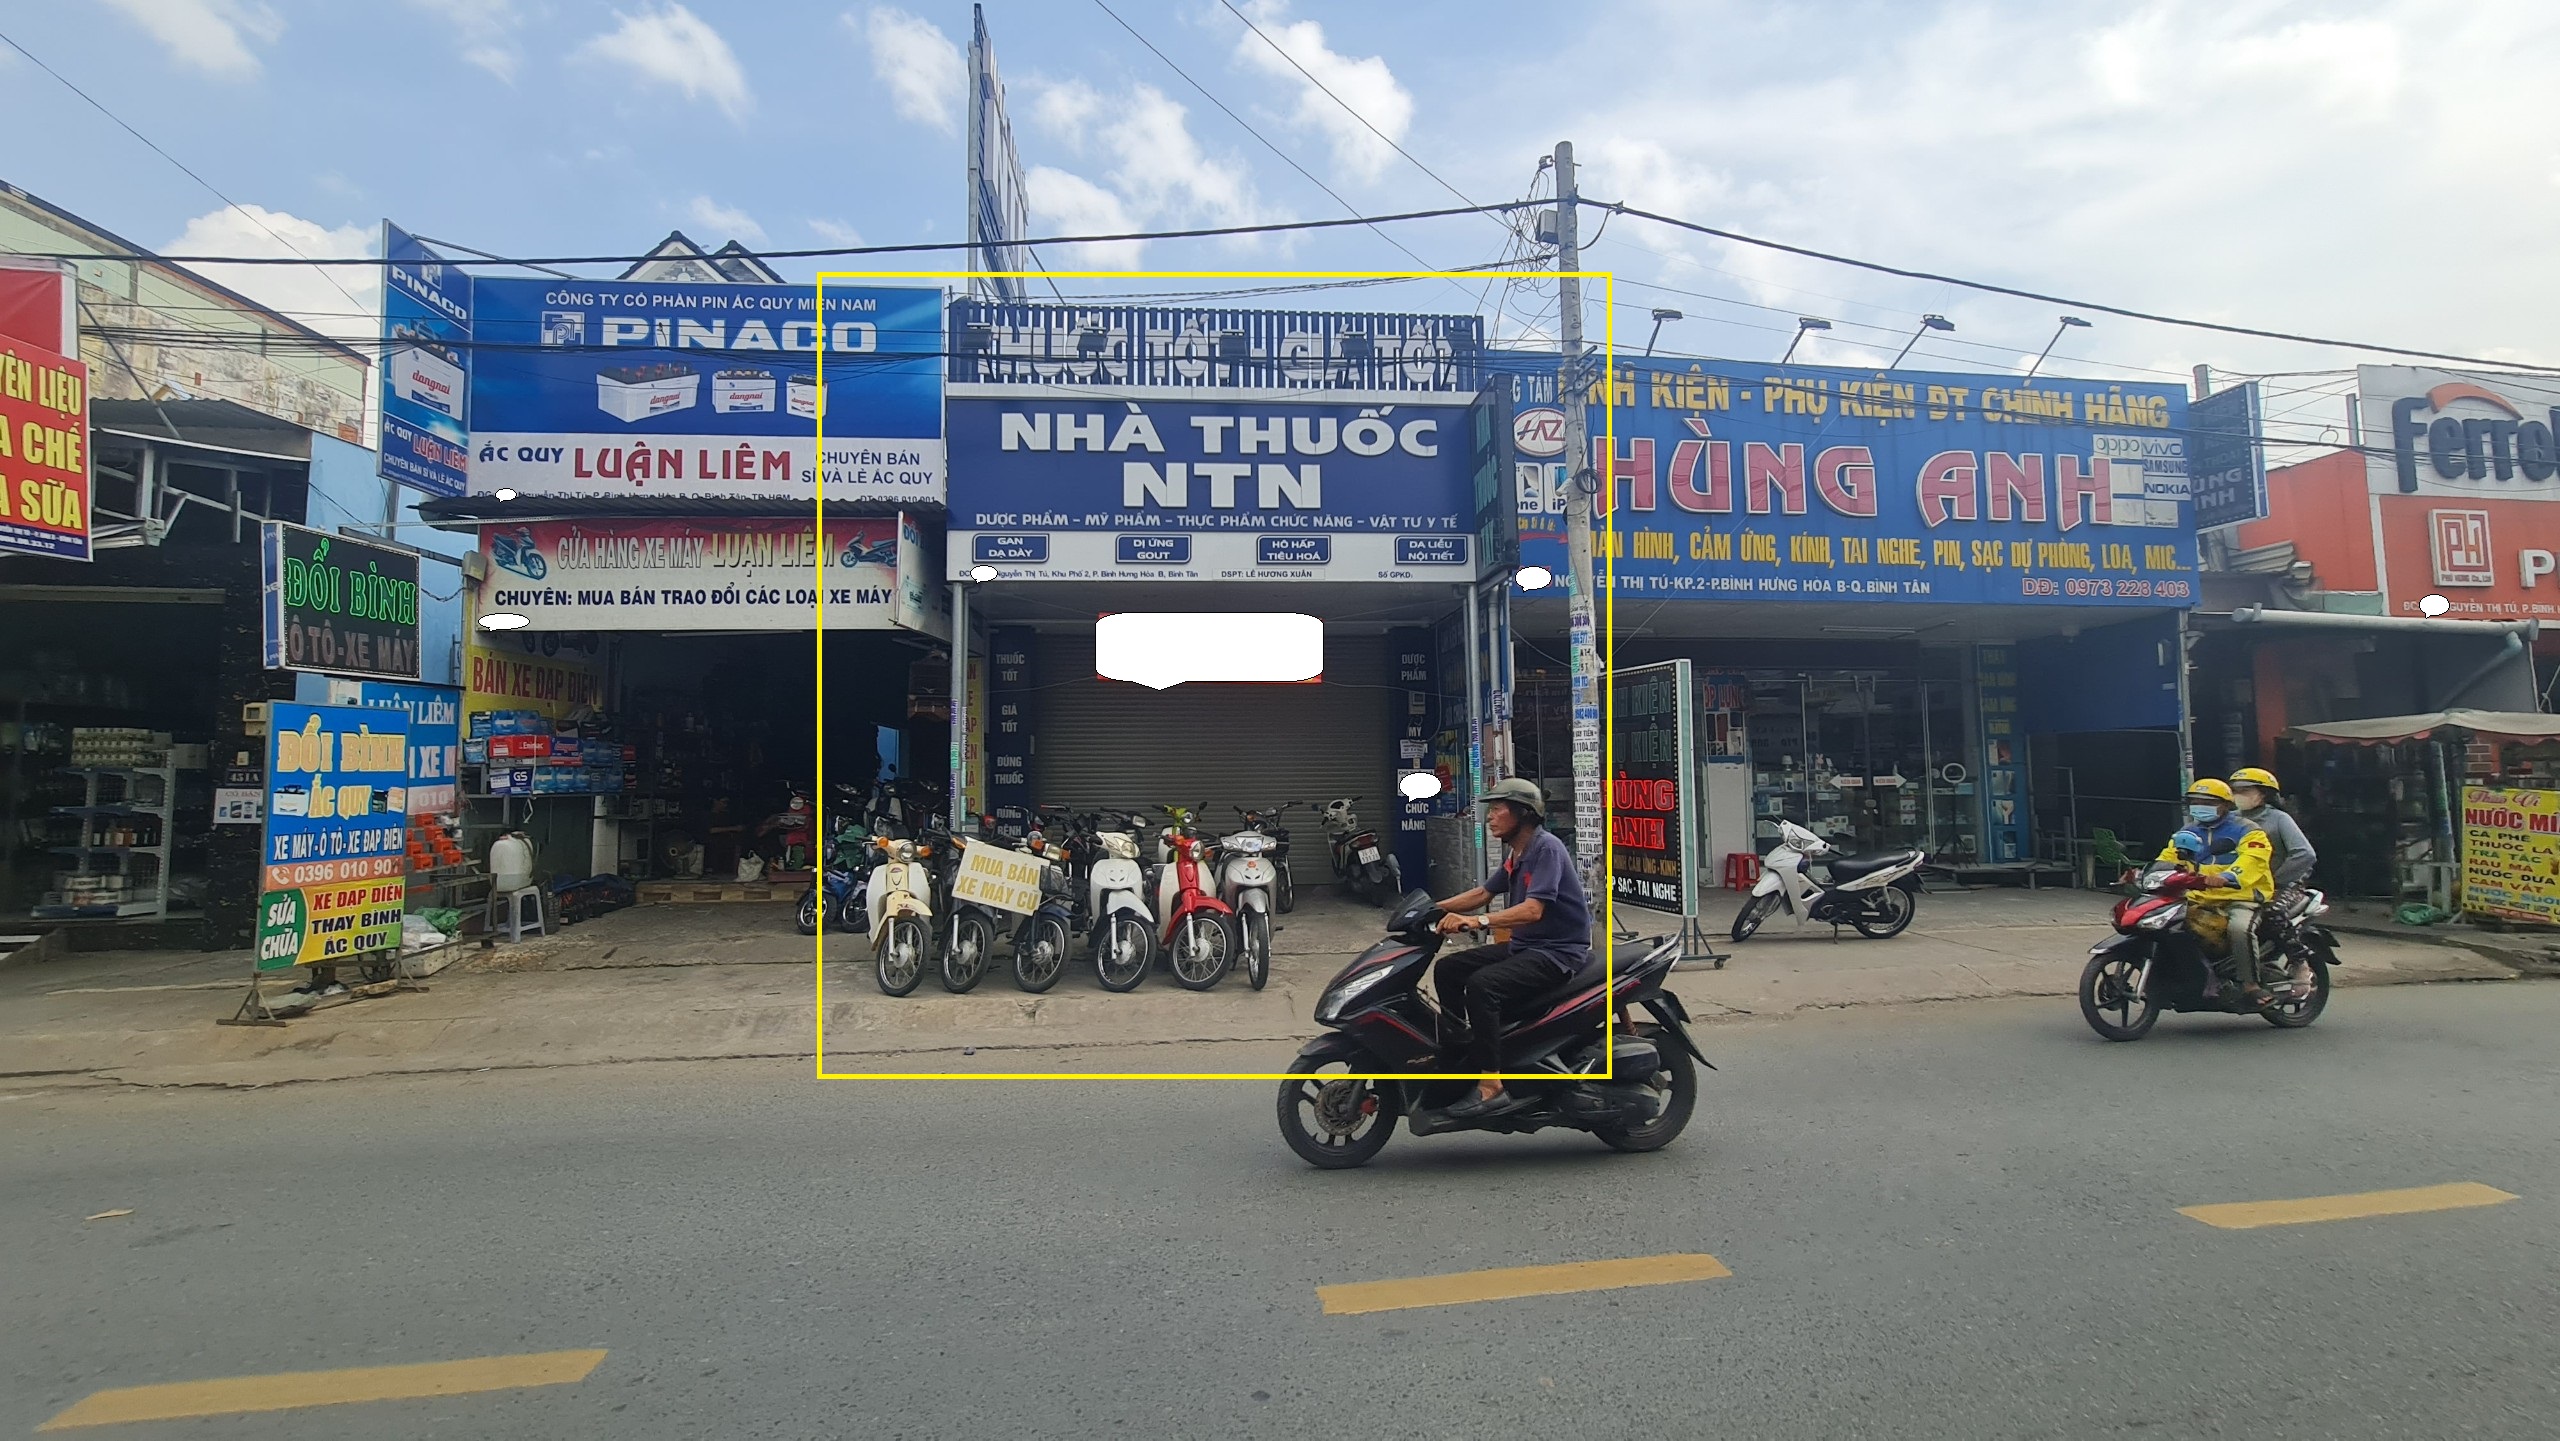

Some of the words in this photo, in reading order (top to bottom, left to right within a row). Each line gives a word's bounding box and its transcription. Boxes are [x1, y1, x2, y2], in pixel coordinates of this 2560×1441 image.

[391, 266, 467, 320] PINACO
[545, 290, 594, 306] CÔNG
[599, 294, 620, 307] TY
[702, 296, 727, 309] PIN
[759, 298, 793, 310] QUY
[841, 298, 877, 312] NAM
[602, 315, 877, 352] PINACO
[39, 365, 82, 420] LIỆU
[1651, 364, 1730, 418] KIỆN
[1763, 377, 1828, 424] PHỤ
[1839, 371, 1914, 427] KIỆN
[1981, 379, 2074, 425] CHÍNH
[2084, 385, 2171, 429] HÃNG
[1001, 401, 1166, 453] NHÀ
[1190, 405, 1438, 457] THUỐC
[22, 420, 83, 474] CHẾ
[397, 426, 412, 442] QUY
[444, 445, 468, 473] LIÊM
[887, 449, 920, 466] BÁN
[2095, 437, 2140, 455] oppo
[2143, 440, 2183, 456] vivo
[479, 440, 509, 463] ẮC
[518, 447, 564, 463] QUY
[574, 440, 683, 487] LUẬN
[699, 442, 791, 481] LIÊM
[1592, 417, 1878, 521] HÙNG
[1915, 450, 2114, 532] ANH
[2143, 459, 2187, 474] SAMSUNG
[821, 466, 842, 484] VÀ
[899, 472, 933, 486] QUY
[1123, 461, 1321, 508] NTN
[2144, 483, 2191, 496] NOKIA
[20, 478, 83, 530] SỮA
[976, 513, 1018, 529] DƯỢC
[1022, 509, 1069, 526] PHẨM
[1085, 512, 1109, 526] MỸ
[1115, 510, 1162, 527] PHẨM
[1178, 513, 1214, 530] THỰC
[1220, 511, 1266, 528] PHẨM
[1270, 513, 1308, 528] CHỨC
[1313, 513, 1353, 529] NĂNG
[1369, 512, 1398, 530] VẬT
[1402, 516, 1423, 529] TƯ
[1426, 517, 1437, 529] Y
[1441, 513, 1458, 530] TẾ
[557, 525, 591, 569] CỬA
[594, 529, 640, 569] HÀNG
[643, 537, 665, 569] XE
[669, 527, 705, 569] MÁY
[710, 525, 774, 577] LUẬN
[997, 536, 1024, 546] GAN
[1133, 539, 1146, 550] DỊ
[1148, 536, 1174, 548] ỨNG
[1272, 537, 1289, 549] HÔ
[1291, 537, 1316, 549] HẤP
[1409, 540, 1425, 549] DA
[1690, 526, 1732, 561] CẢM
[1841, 537, 1869, 564] TAI
[1933, 539, 1966, 571] PIN,
[1971, 540, 2004, 574] SẠC
[2011, 537, 2033, 575] DỰ
[2101, 544, 2138, 575] LOA,
[988, 549, 1006, 560] DẠ
[1008, 547, 1033, 558] DÀY
[1136, 551, 1171, 560] GOUT
[1267, 551, 1297, 561] TIÊU
[1298, 550, 1321, 562] HOÁ
[1408, 552, 1429, 563] NỘI
[1431, 550, 1455, 562] TIẾT
[286, 537, 341, 613] ĐỔI
[350, 560, 417, 625] BÌNH
[1052, 569, 1067, 578] Khu
[1068, 567, 1084, 578] Phố
[1118, 570, 1139, 580] Hưng
[1221, 570, 1244, 579] DSPT:
[1245, 568, 1256, 578] LÊ
[1257, 569, 1287, 579] HƯƠNG
[1288, 568, 1313, 579] XUÂN
[1620, 577, 1644, 593] THỊ
[1758, 575, 1798, 592] HƯNG
[1802, 576, 1832, 592] HÒA
[1903, 580, 1930, 594] TÂN
[495, 587, 572, 606] CHUYÊN:
[577, 590, 615, 605] MUA
[621, 586, 656, 605] BÁN
[661, 588, 707, 605] TRAO
[711, 582, 741, 604] ĐỔI
[745, 585, 782, 605] CÁC
[829, 588, 851, 604] XE
[856, 585, 892, 605] MÁY
[2065, 578, 2113, 597] 0973
[2116, 581, 2151, 597] 228
[2154, 581, 2191, 598] 403
[377, 629, 416, 672] MÁY
[996, 650, 1025, 665] THUỐC
[1401, 653, 1426, 666] DƯỢC
[473, 649, 508, 695] BÁN
[511, 662, 532, 698] XE
[418, 694, 455, 725] LIÊM
[1001, 704, 1018, 716] GIÁ
[277, 713, 333, 772] ĐỔI
[340, 724, 405, 772] BÌNH
[419, 745, 442, 778] XE
[337, 785, 372, 820] QUY
[1405, 801, 1430, 814] CHỨC
[2465, 807, 2523, 830] NƯỚC
[1609, 816, 1665, 850] ANH
[274, 835, 289, 861] XE
[294, 865, 333, 883] 0396
[340, 861, 370, 879] 010
[970, 854, 1004, 878] MUA
[1007, 862, 1039, 885] BÁN
[313, 890, 332, 911] XE
[336, 887, 366, 911] ĐẠP
[372, 882, 403, 906] ĐIỆN
[956, 875, 979, 896] XE
[980, 882, 1015, 905] MÁY
[1017, 889, 1039, 911] CŨ
[1652, 881, 1677, 902] NGHE
[268, 893, 296, 927] SỬA
[311, 914, 355, 936] THAY
[361, 907, 402, 927] BÌNH
[260, 927, 299, 961] CHỮA
[354, 932, 388, 951] QUY
